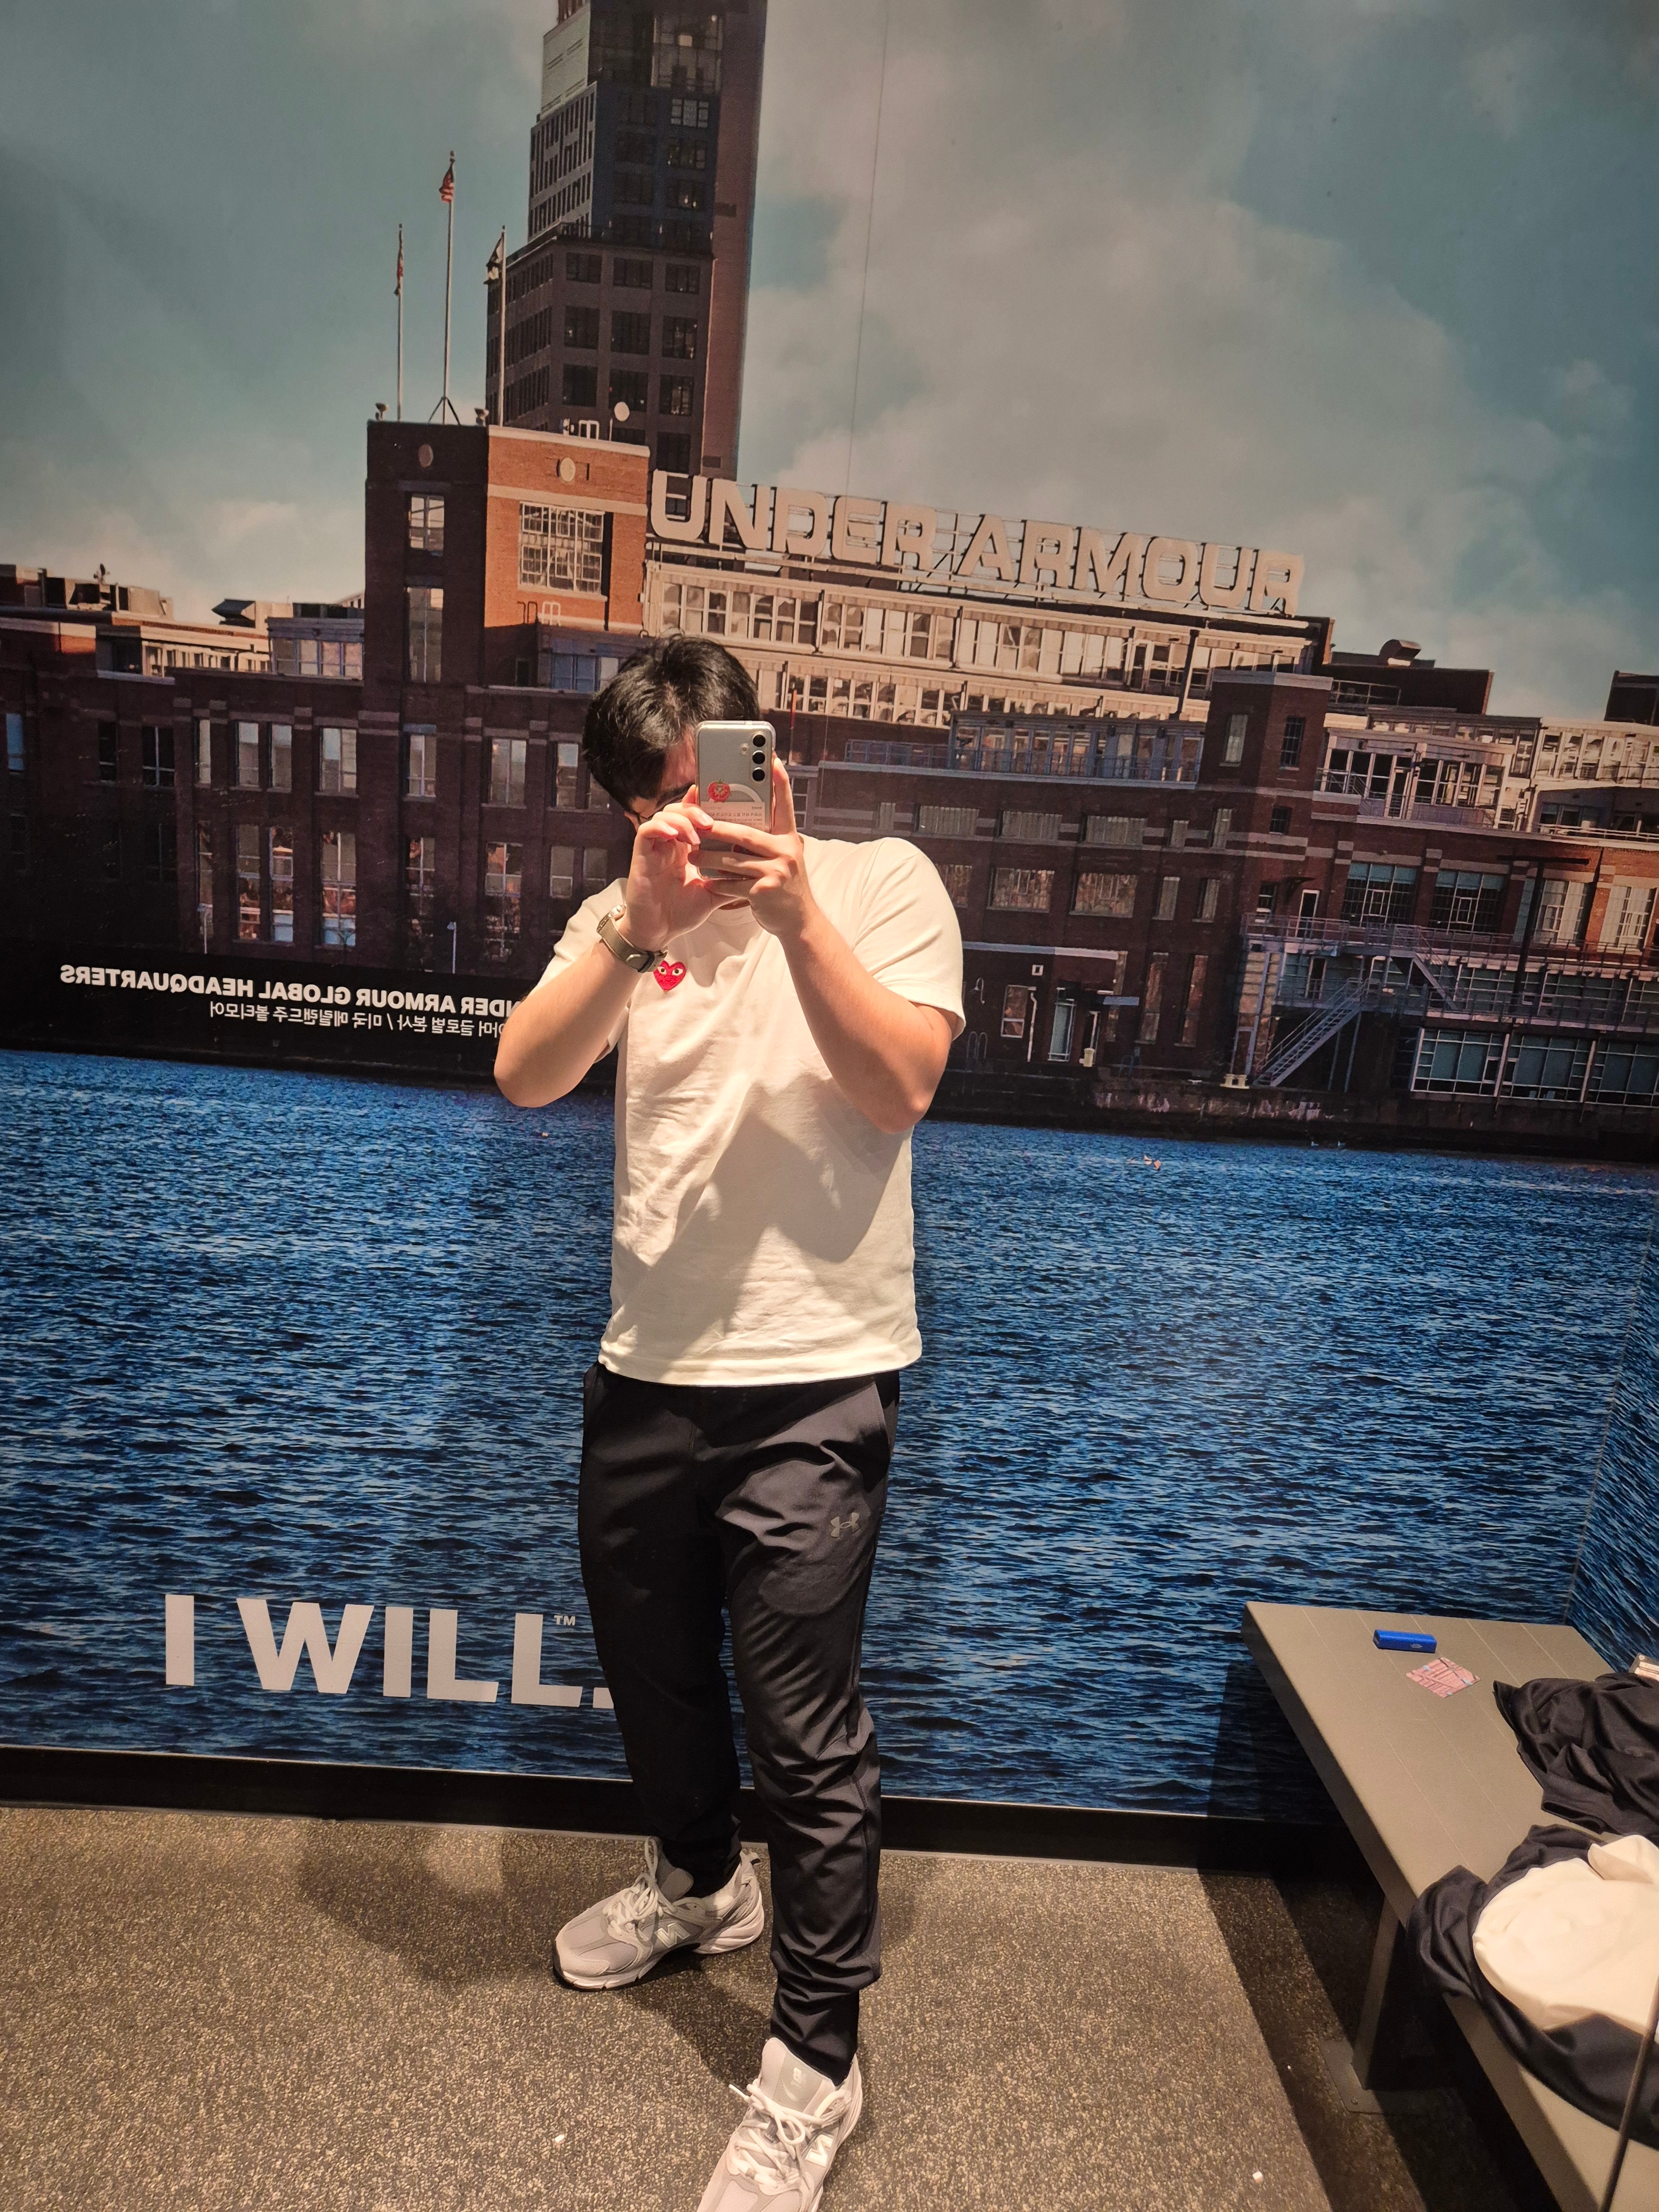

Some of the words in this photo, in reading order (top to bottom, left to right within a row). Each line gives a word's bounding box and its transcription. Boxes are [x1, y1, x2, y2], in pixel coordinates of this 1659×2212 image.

[651, 469, 936, 571] UNDER
[954, 513, 1305, 617] ARMOUR
[165, 1594, 195, 1686] I
